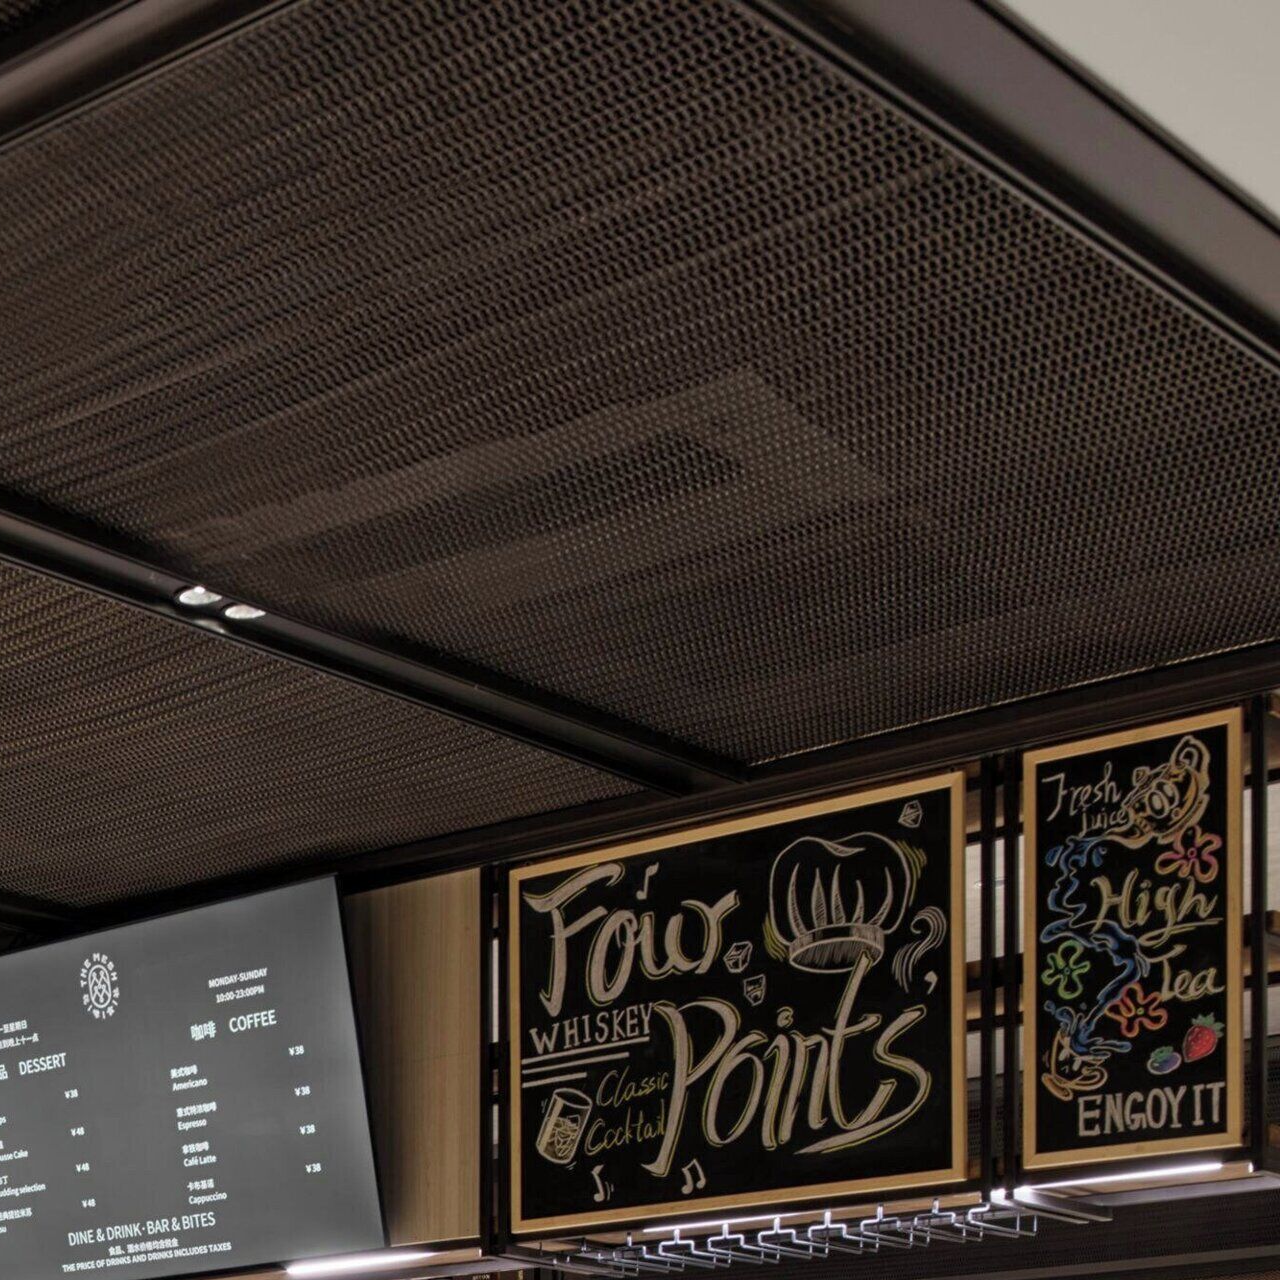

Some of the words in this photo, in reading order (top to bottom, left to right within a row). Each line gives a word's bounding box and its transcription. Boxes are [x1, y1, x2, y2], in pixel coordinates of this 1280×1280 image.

[1041, 761, 1122, 822] Fresh
[1089, 868, 1219, 950] High
[523, 862, 740, 1018] Four
[208, 967, 267, 988] MONDAY-SUNDAY
[1144, 943, 1226, 1002] Tea
[190, 1020, 216, 1040] 咖啡
[229, 1009, 276, 1032] COFFEE
[530, 1002, 653, 1056] WHISKEY
[18, 1052, 66, 1075] DESSERT
[642, 951, 932, 1178] Points
[172, 1078, 207, 1091] Americano
[595, 1069, 670, 1109] Classic
[177, 1119, 206, 1131] Espresso
[1078, 1082, 1188, 1138] ENGOY
[1193, 1080, 1227, 1126] IT
[583, 1100, 666, 1157] Cocktail
[13, 1149, 28, 1159] Cake
[183, 1155, 198, 1167] Café
[199, 1155, 216, 1164] Latte
[18, 1183, 46, 1194] selection
[188, 1191, 227, 1205] Cappuccino
[68, 1229, 95, 1246] DINE
[96, 1228, 105, 1242] &
[171, 1217, 181, 1231] &
[181, 1211, 215, 1229] BITES
[62, 1263, 76, 1272] THE
[76, 1260, 95, 1270] PRICE
[95, 1259, 105, 1268] OF
[105, 1255, 131, 1266] DRINKS
[132, 1254, 146, 1263] AND
[147, 1250, 173, 1261] DRINKS
[173, 1245, 208, 1257] INCLUDES
[208, 1242, 231, 1252] TAXES
